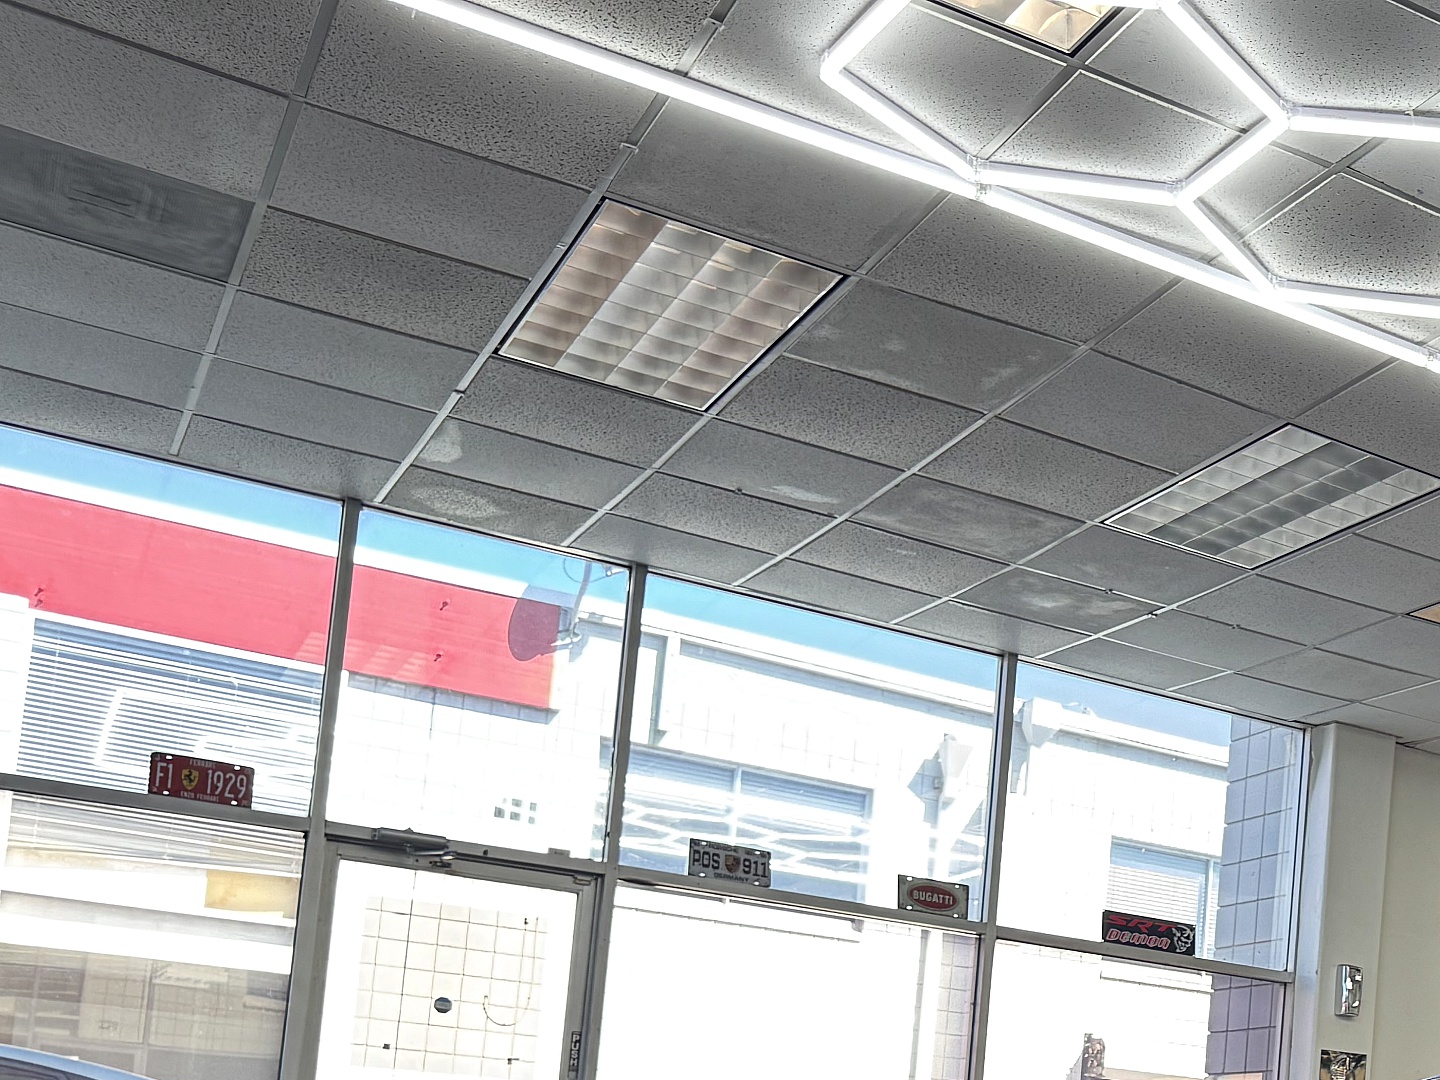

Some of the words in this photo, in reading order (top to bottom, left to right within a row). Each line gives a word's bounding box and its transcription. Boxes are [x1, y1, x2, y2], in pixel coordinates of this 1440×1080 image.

[155, 762, 174, 789] F1
[207, 769, 248, 799] 1929
[713, 872, 750, 883] GERMANY
[742, 858, 769, 878] 911
[912, 889, 954, 906] BUGATTI
[1106, 914, 1178, 934] SRT
[570, 1034, 580, 1067] PUSH
